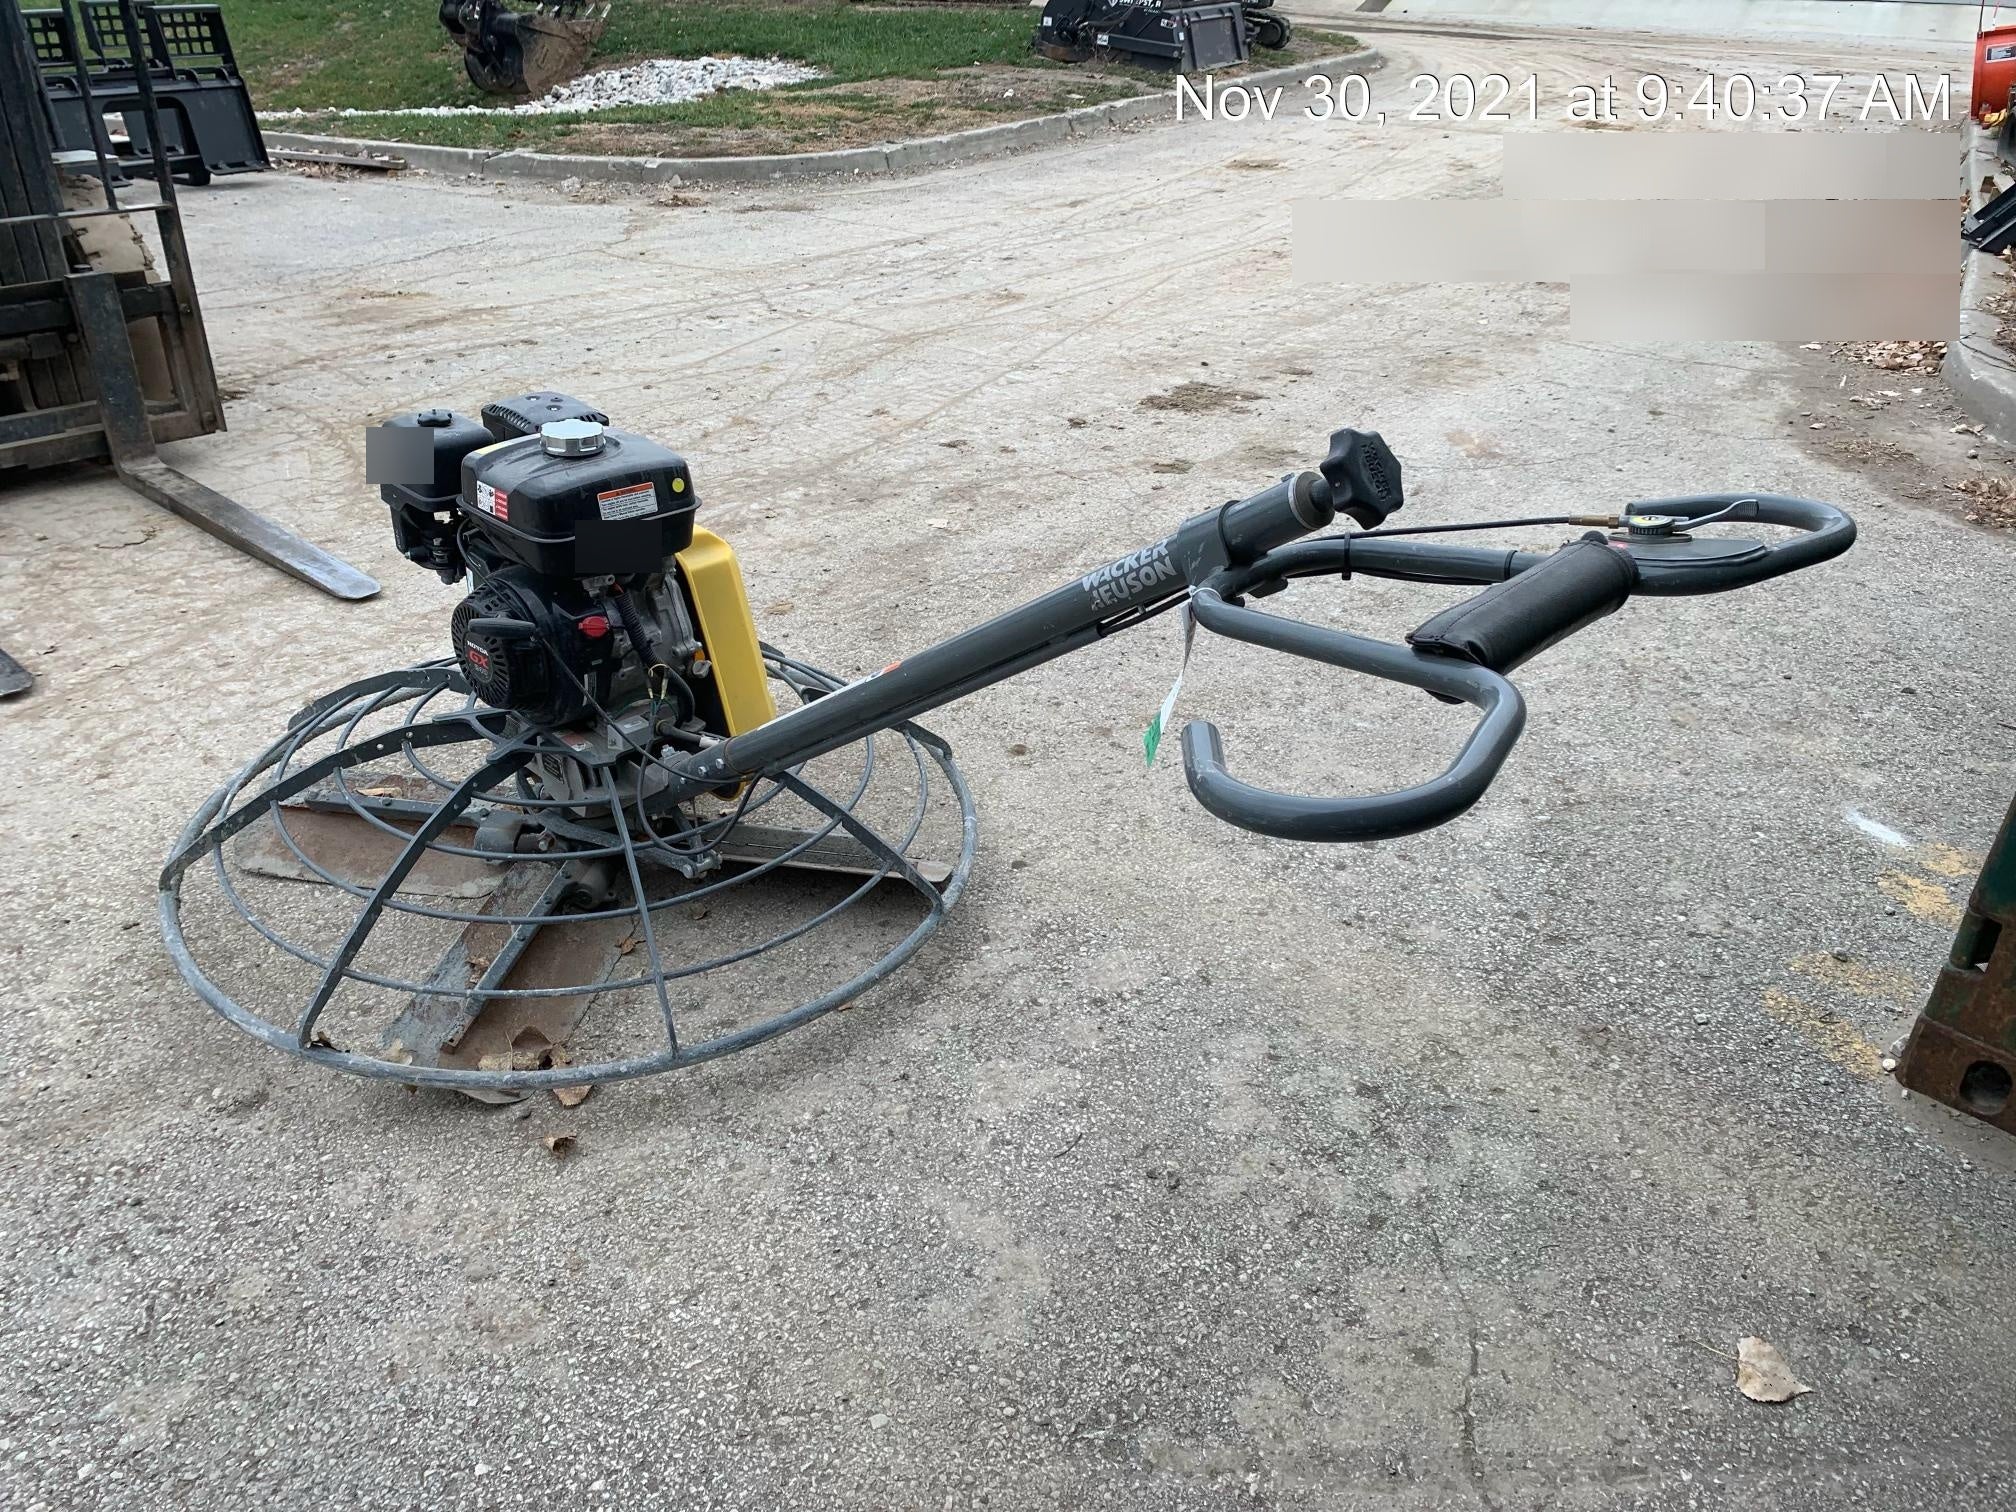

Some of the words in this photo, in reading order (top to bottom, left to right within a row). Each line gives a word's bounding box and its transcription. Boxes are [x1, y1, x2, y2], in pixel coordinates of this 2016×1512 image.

[1082, 539, 1169, 592] WACKER
[466, 640, 489, 656] HONDA
[469, 650, 489, 669] GX
